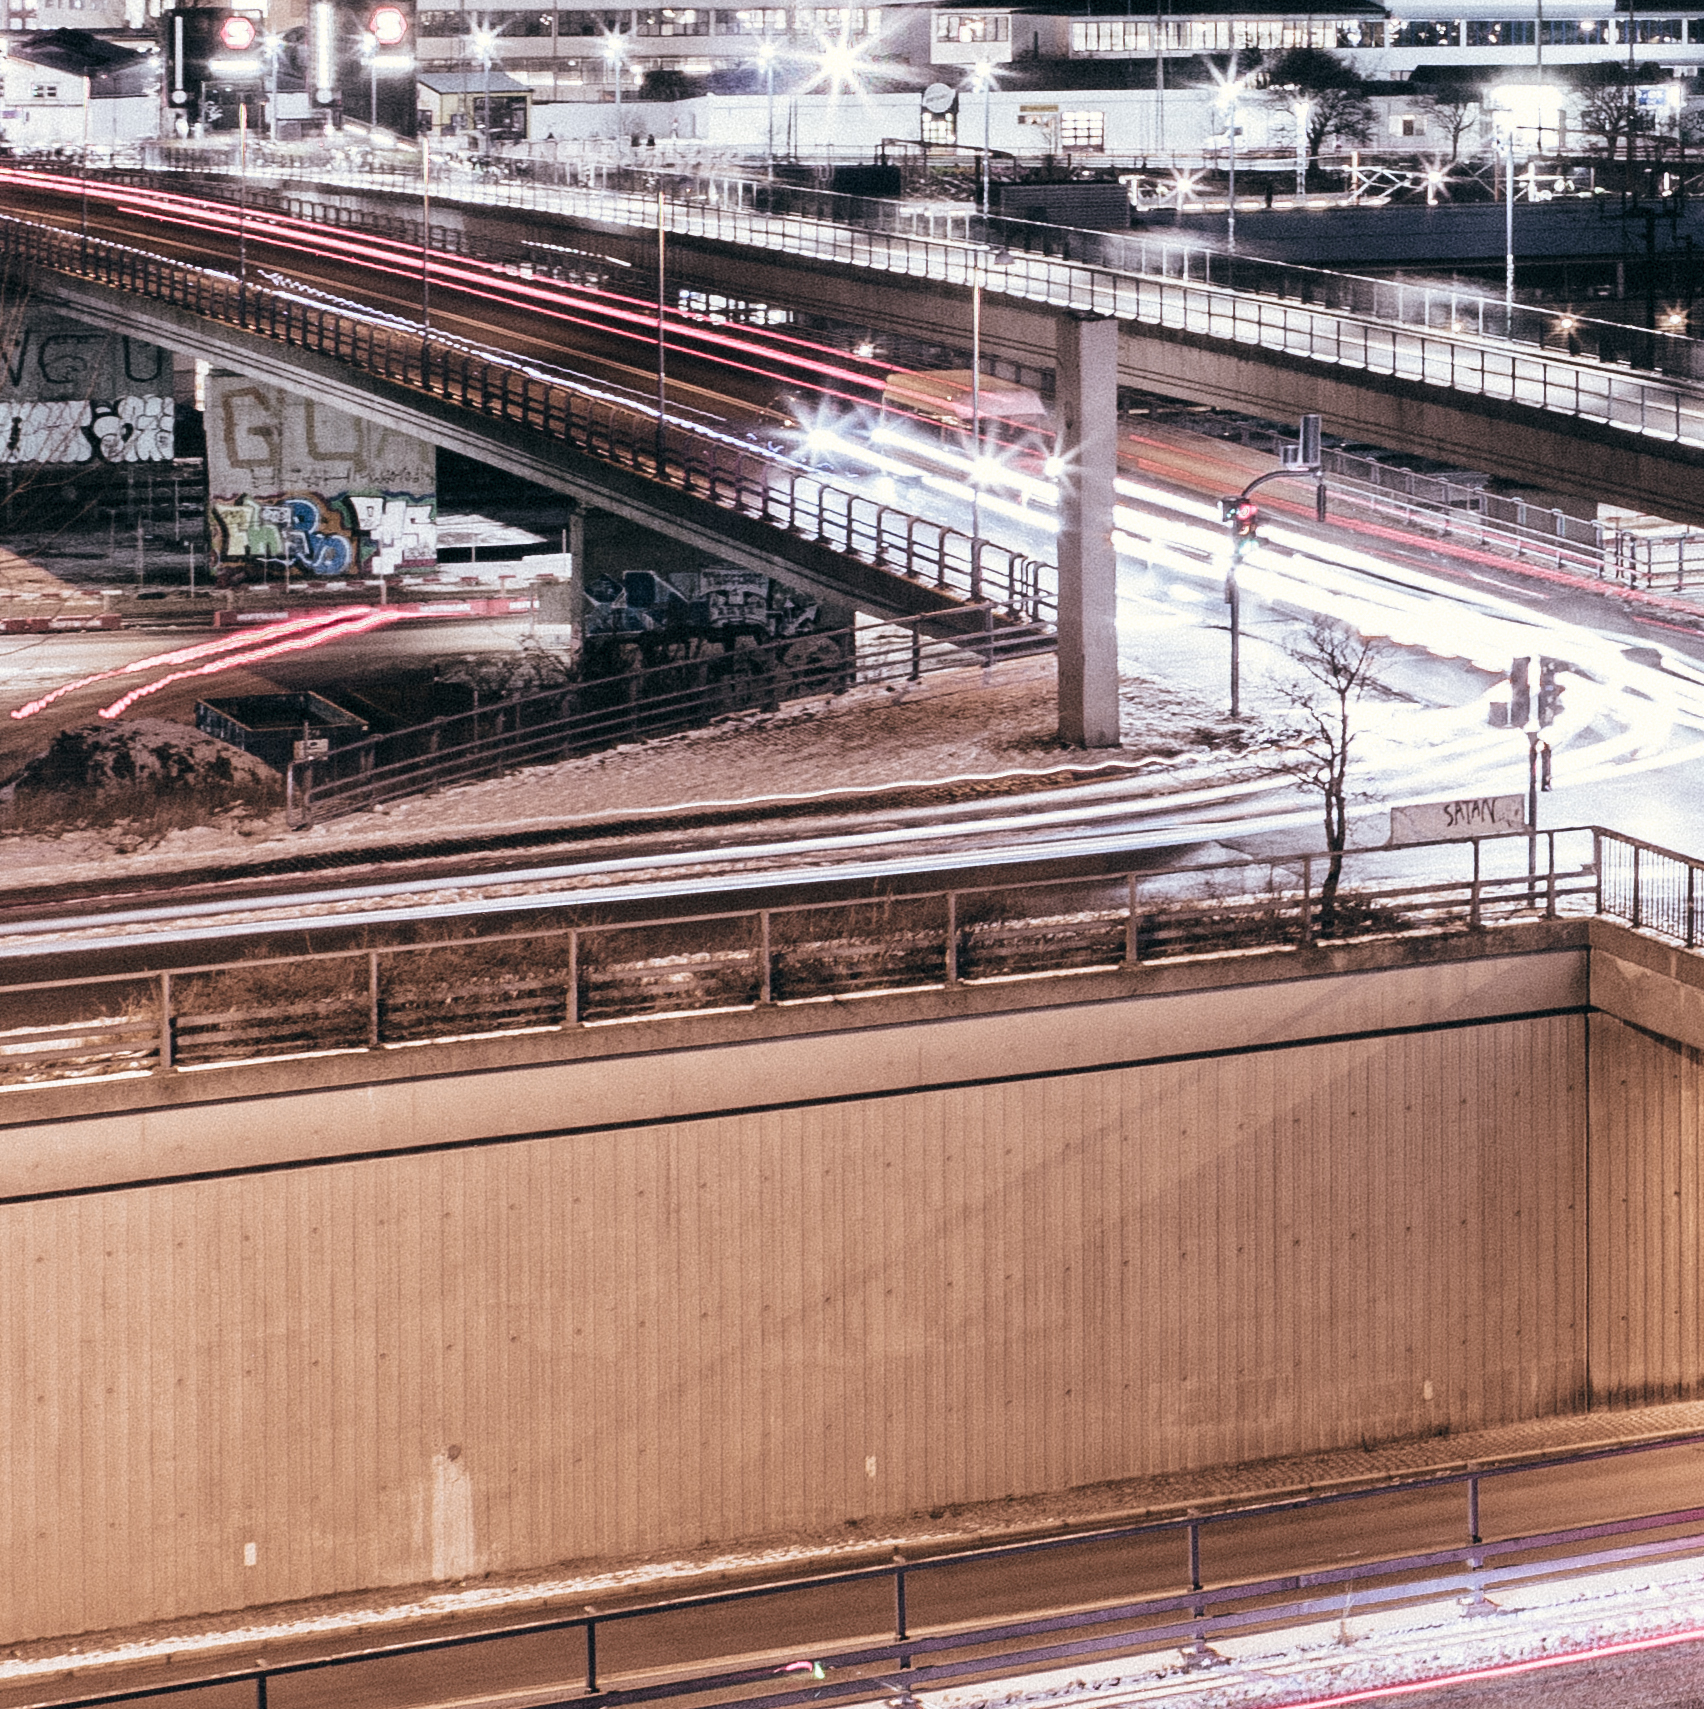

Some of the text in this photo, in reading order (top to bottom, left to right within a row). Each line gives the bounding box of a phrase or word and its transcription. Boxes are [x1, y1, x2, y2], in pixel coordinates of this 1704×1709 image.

[222, 19, 253, 47] S
[371, 9, 403, 42] S
[1444, 798, 1496, 827] SATAN
